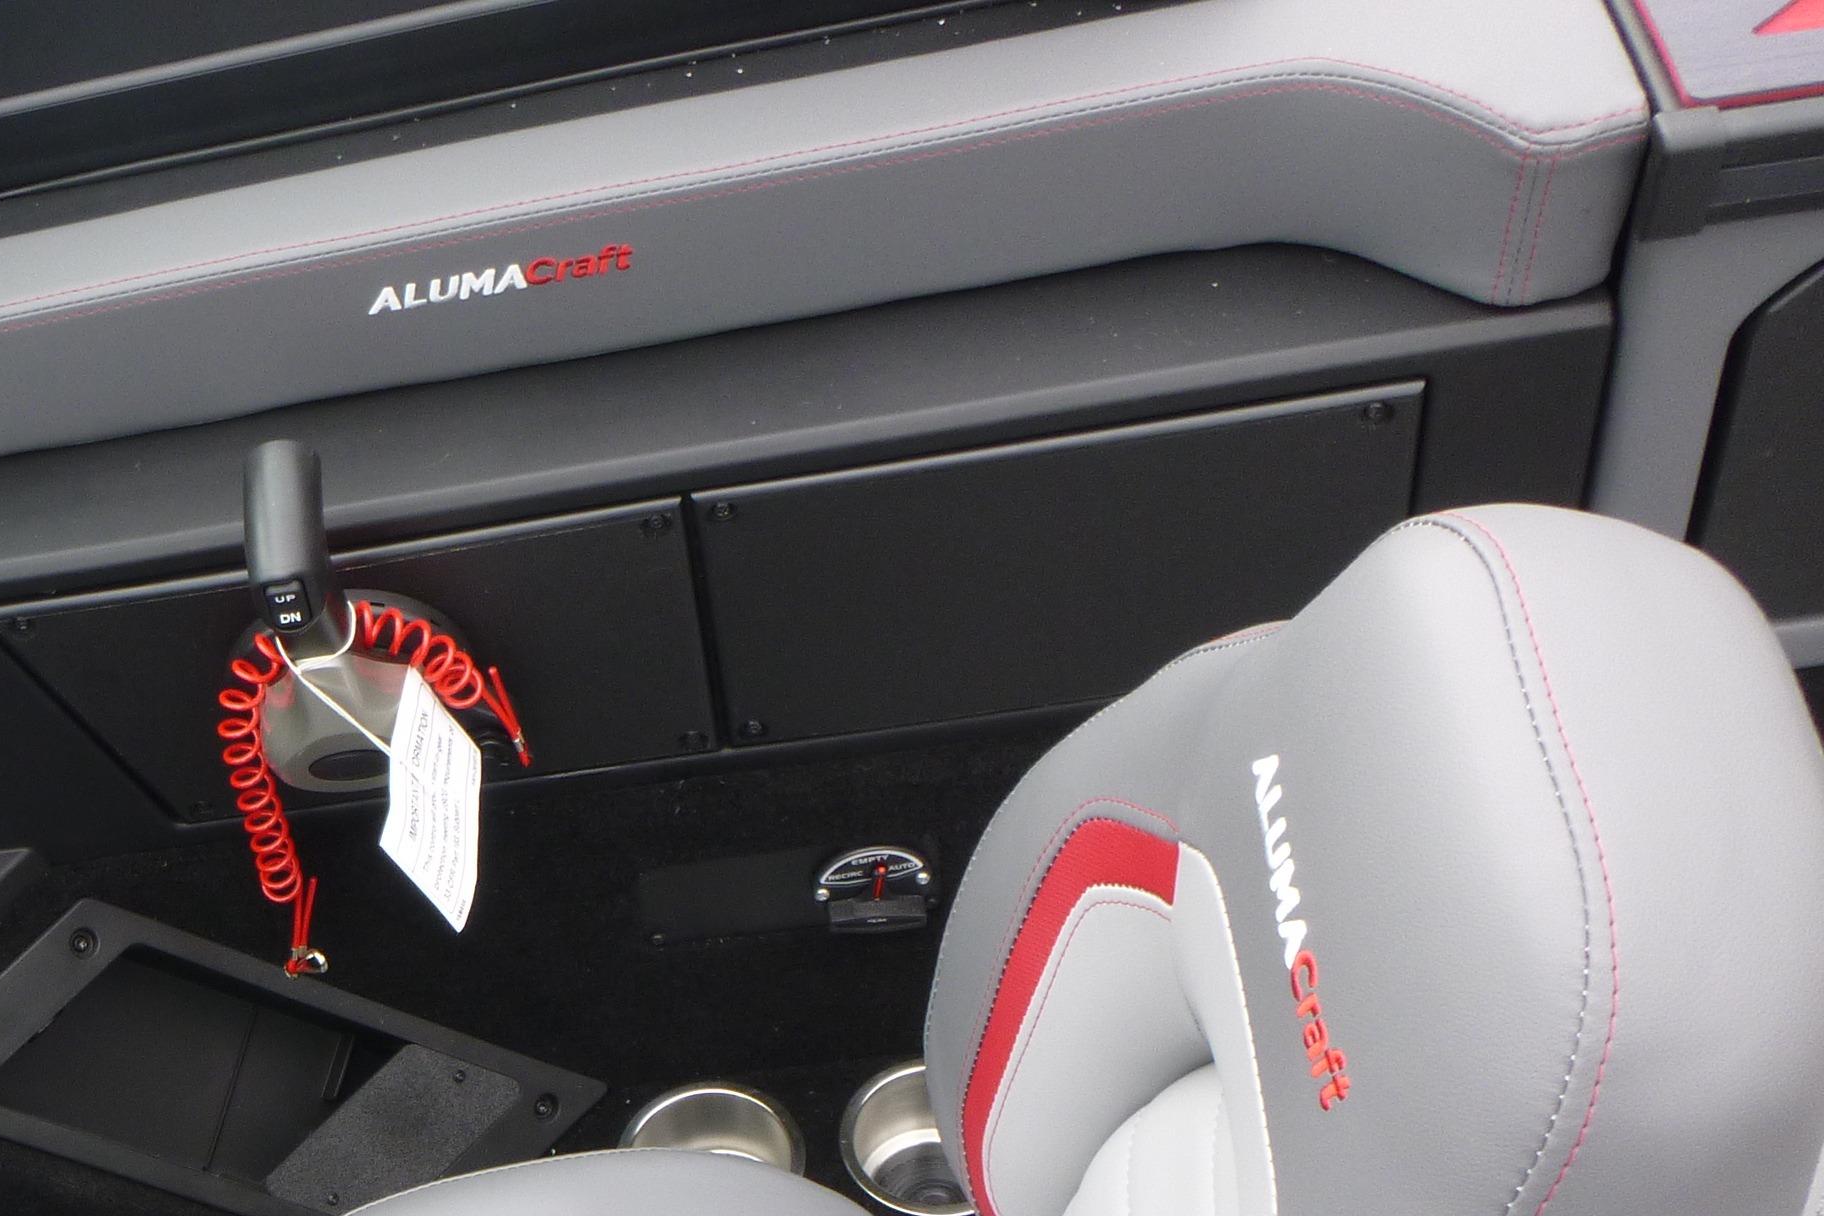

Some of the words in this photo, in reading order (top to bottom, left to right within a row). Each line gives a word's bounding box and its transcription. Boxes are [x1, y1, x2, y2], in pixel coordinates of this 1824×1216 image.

[368, 242, 634, 315] ALUMACraft
[274, 594, 296, 603] UP
[280, 611, 302, 624] DN
[851, 855, 889, 865] EMPTY
[888, 861, 916, 872] AUTO
[828, 870, 863, 881] RECIRC
[1252, 754, 1351, 1111] ALUMACraft
